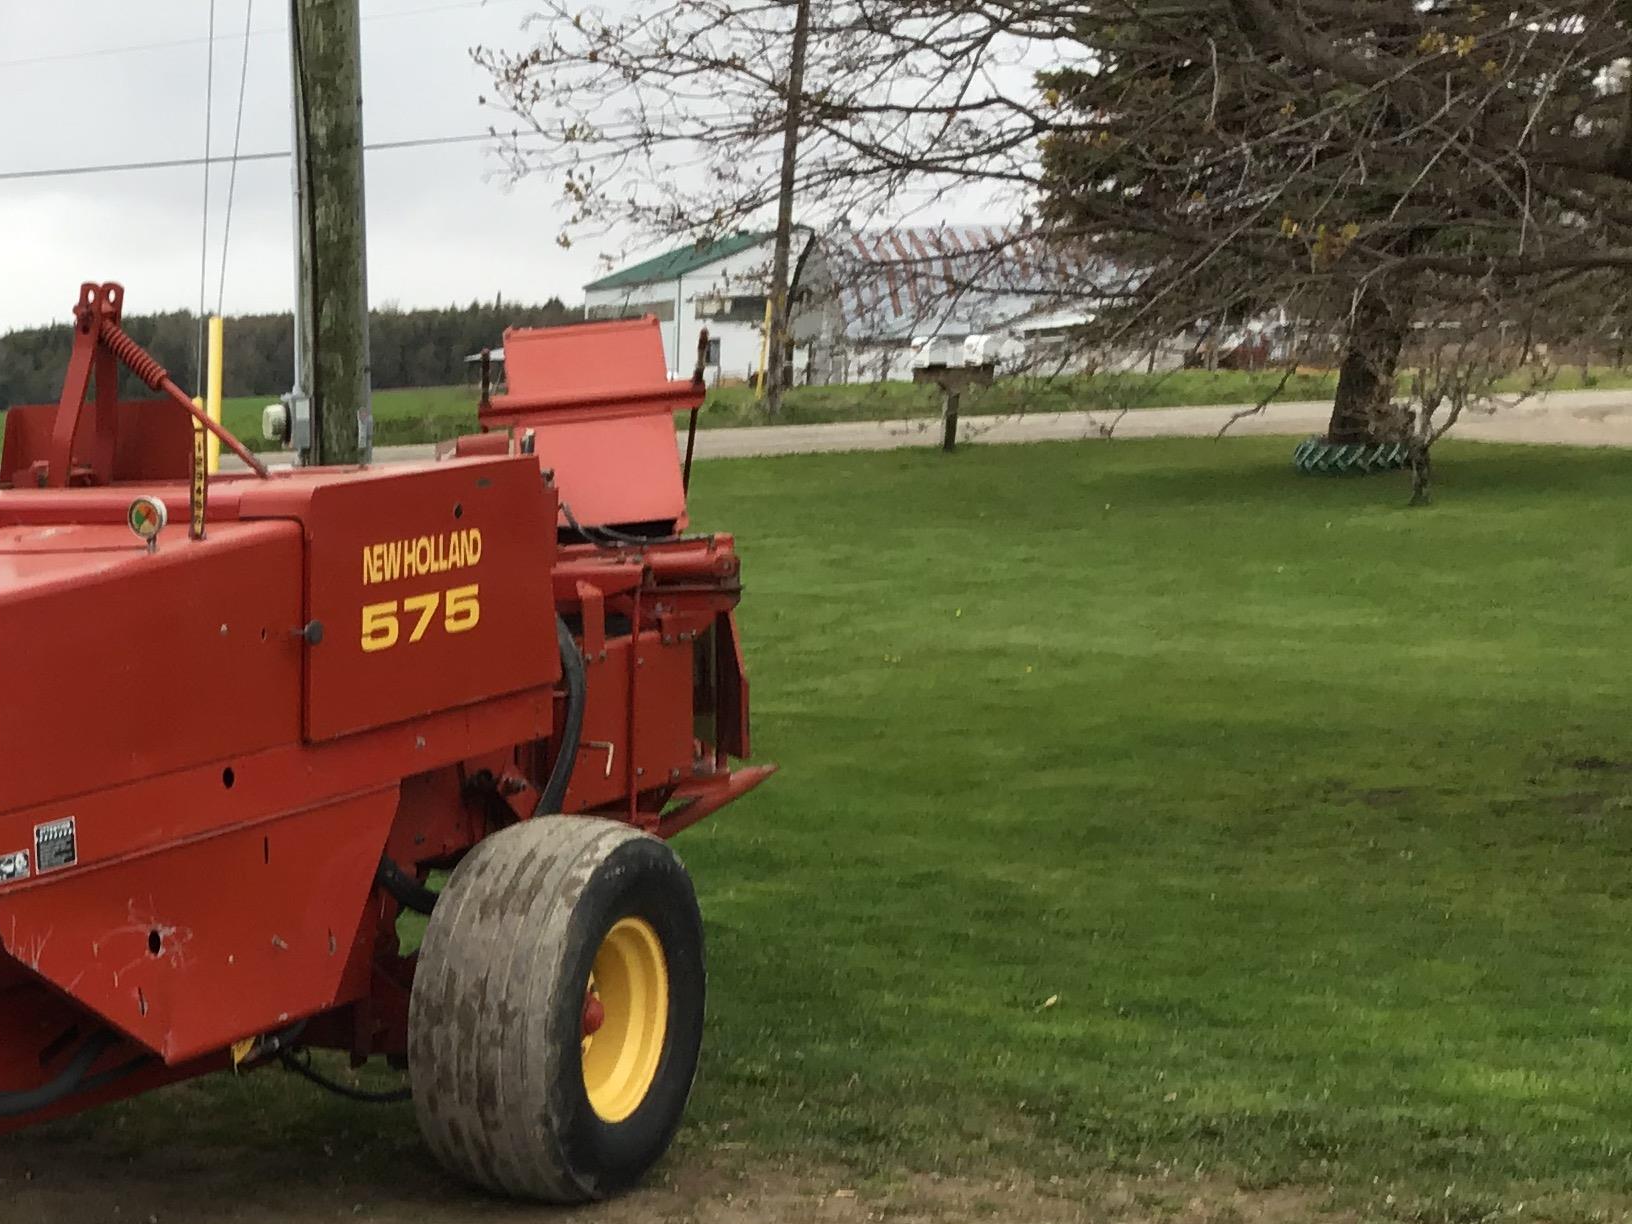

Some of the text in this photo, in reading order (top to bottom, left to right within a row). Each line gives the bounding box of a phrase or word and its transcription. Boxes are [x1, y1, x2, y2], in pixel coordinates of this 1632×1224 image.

[363, 528, 481, 585] NEW HOLLAND
[361, 584, 480, 652] 575
